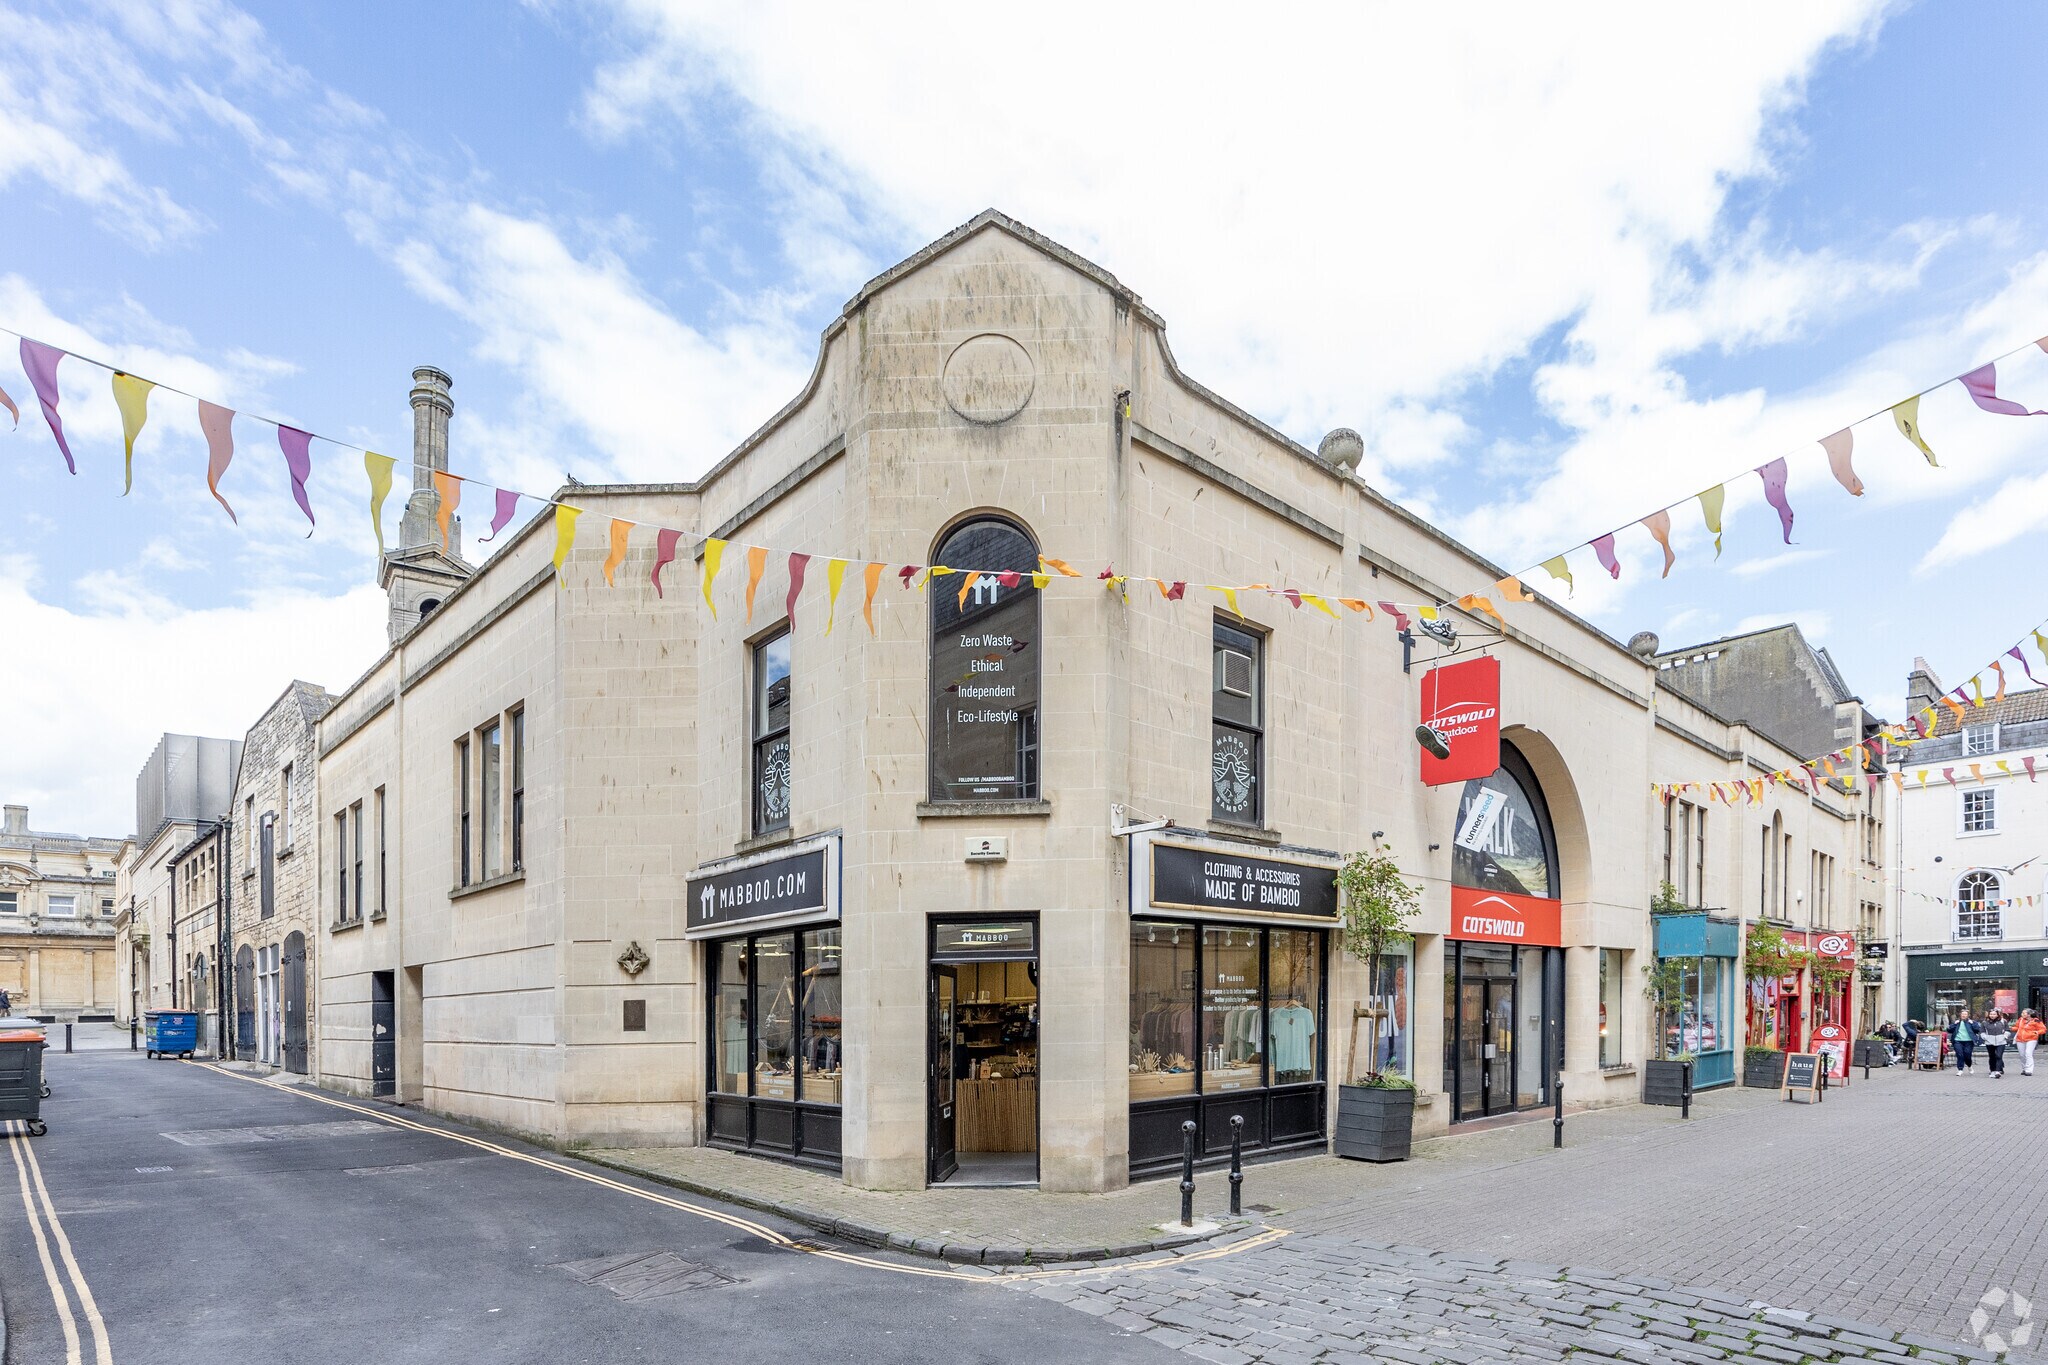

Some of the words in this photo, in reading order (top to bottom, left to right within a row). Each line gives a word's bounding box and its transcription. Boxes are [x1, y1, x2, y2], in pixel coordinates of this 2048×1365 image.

[961, 634, 980, 647] Zero
[983, 634, 1012, 647] Waste
[971, 659, 1004, 672] Ethical
[958, 685, 1016, 700] Independent
[957, 709, 1019, 724] Eco-Lifestyle
[1444, 725, 1478, 737] utdoor
[767, 743, 790, 762] MABBO
[1215, 735, 1249, 756] MABBOO
[1215, 796, 1248, 812] BAMBOO
[1465, 793, 1494, 844] runnersneed
[1204, 861, 1242, 879] CLOTHING
[1246, 866, 1252, 880] &
[1255, 868, 1300, 886] ACCESSORIES
[720, 871, 806, 909] MABBOO.COM
[1205, 879, 1236, 900] MADE
[1242, 883, 1255, 902] OF
[1260, 885, 1300, 907] BAMBOO
[1462, 915, 1525, 937] COTSWOLD
